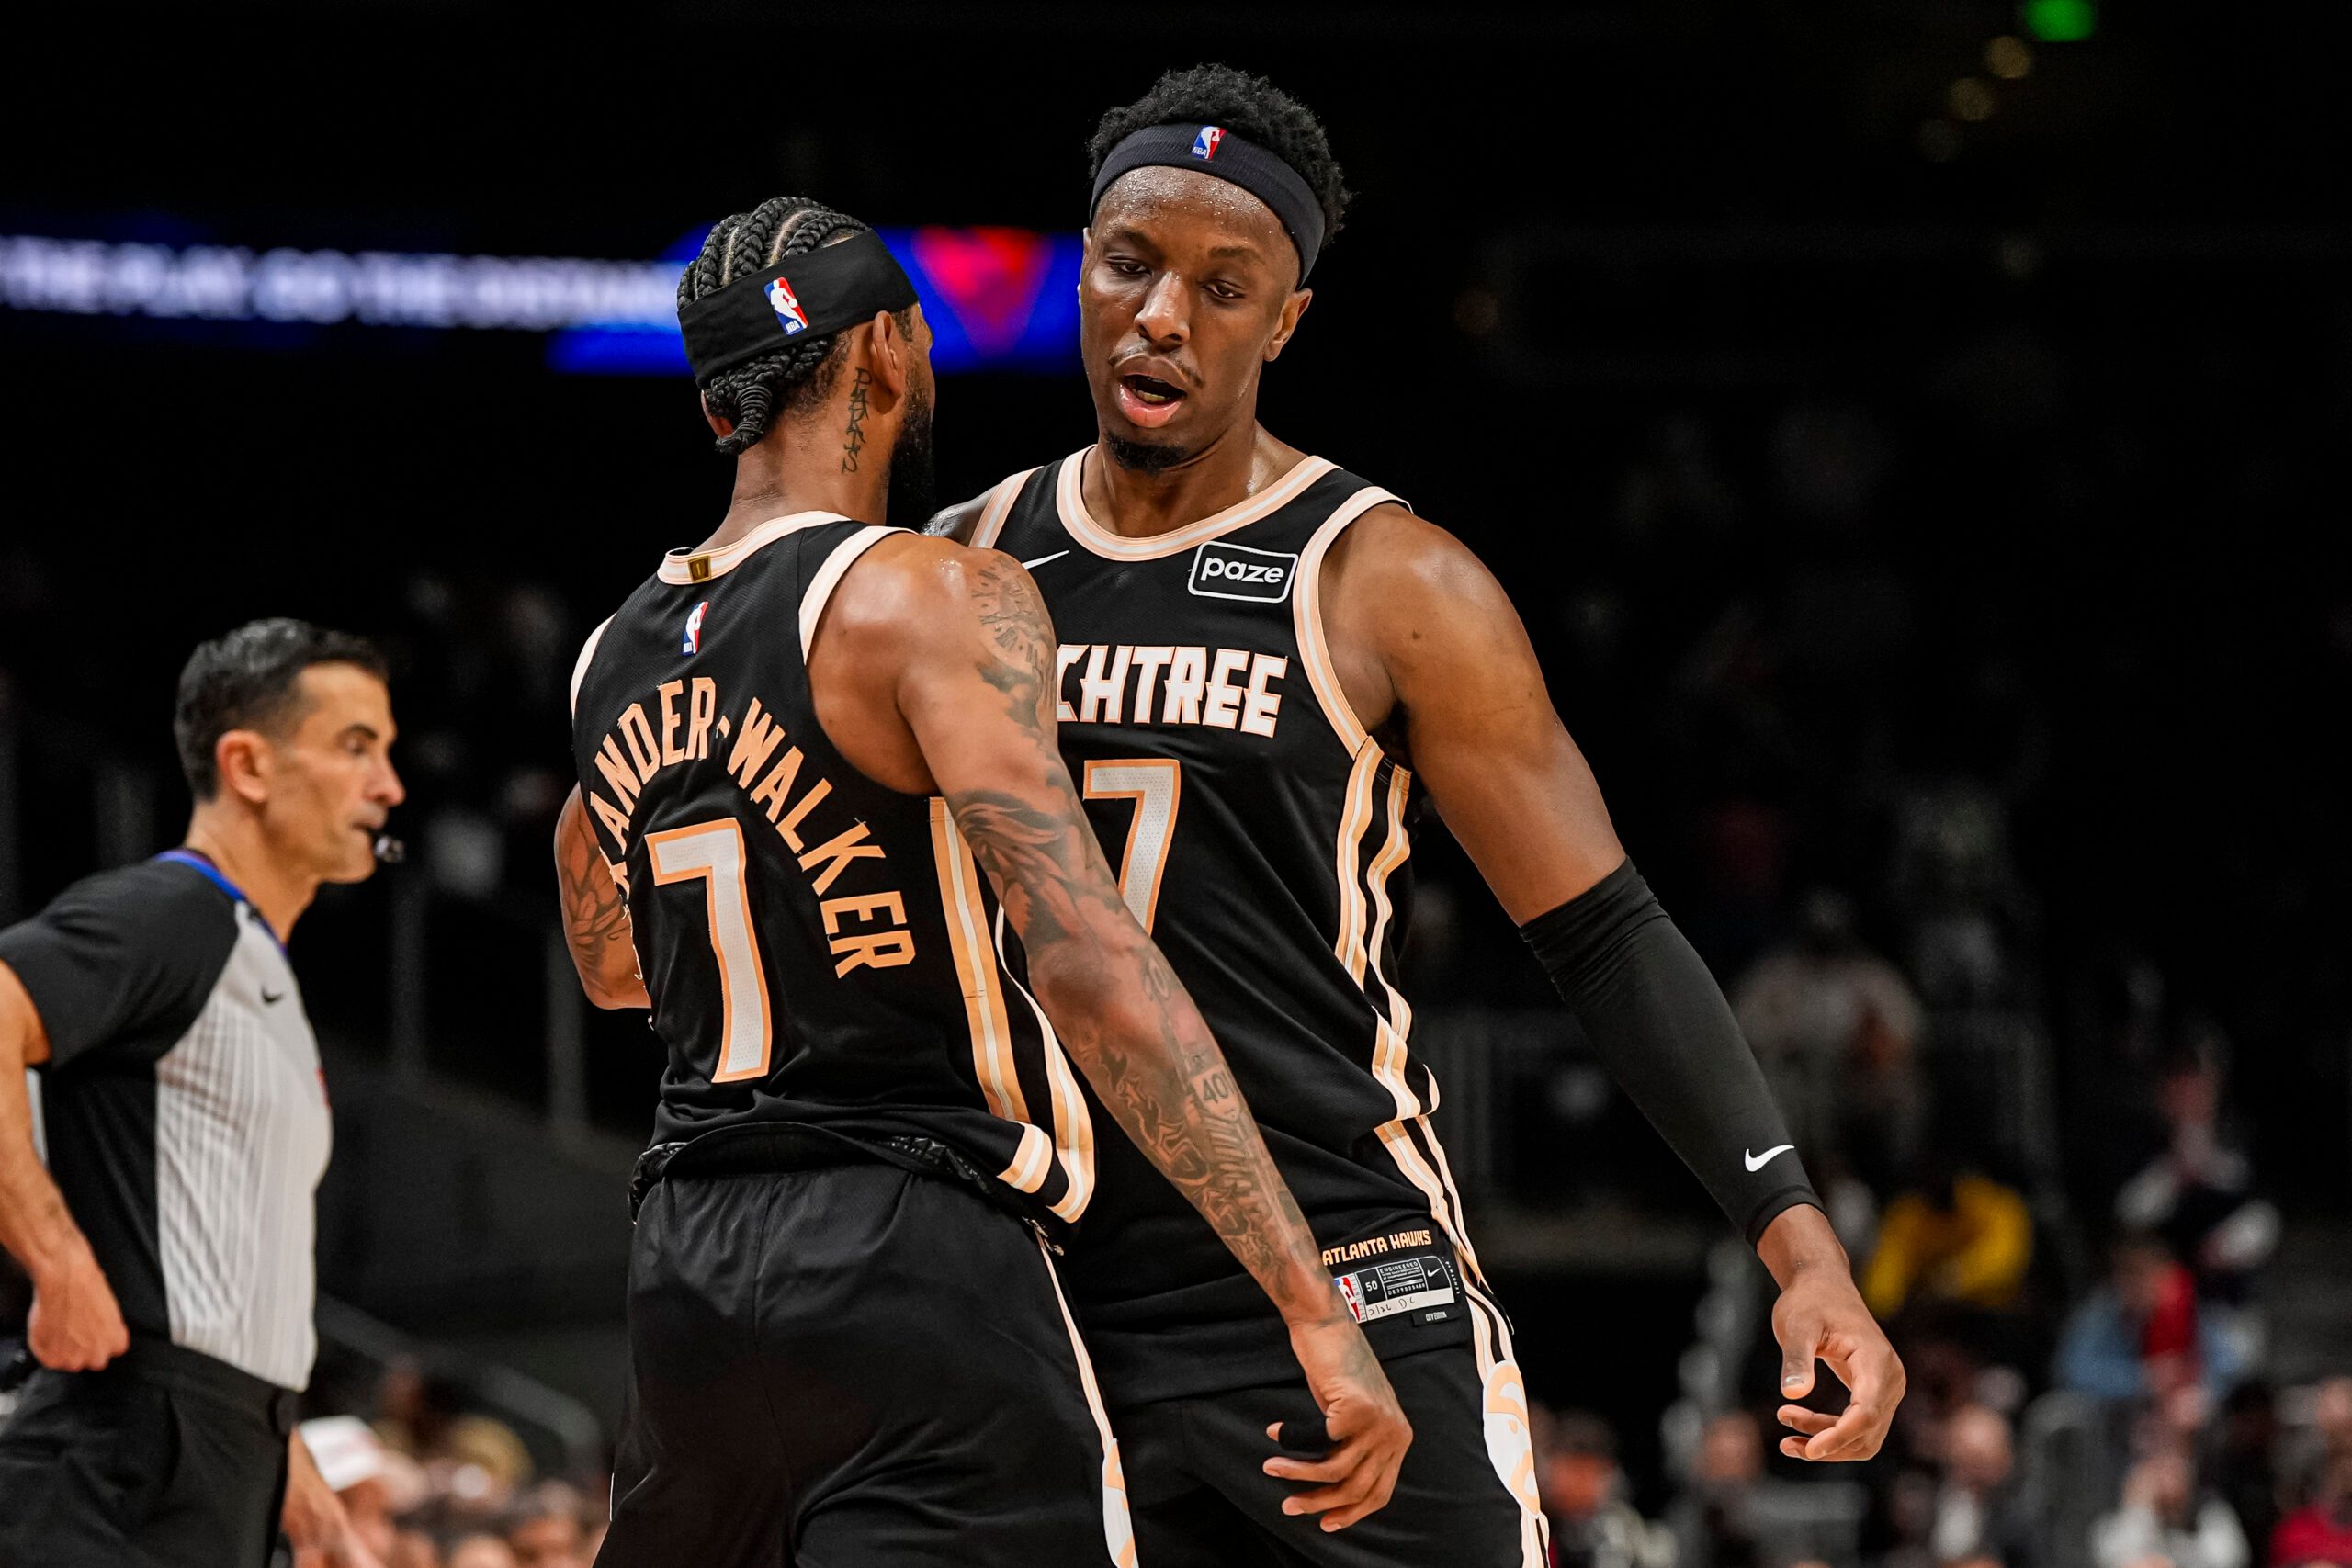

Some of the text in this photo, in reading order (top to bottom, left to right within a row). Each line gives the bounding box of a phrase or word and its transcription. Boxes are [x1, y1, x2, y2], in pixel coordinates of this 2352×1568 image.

[1201, 557, 1284, 583] paze
[645, 818, 773, 1083] 7
[1322, 1229, 1432, 1266] ATLANTA HAWKS
[1365, 1280, 1378, 1292] 50
